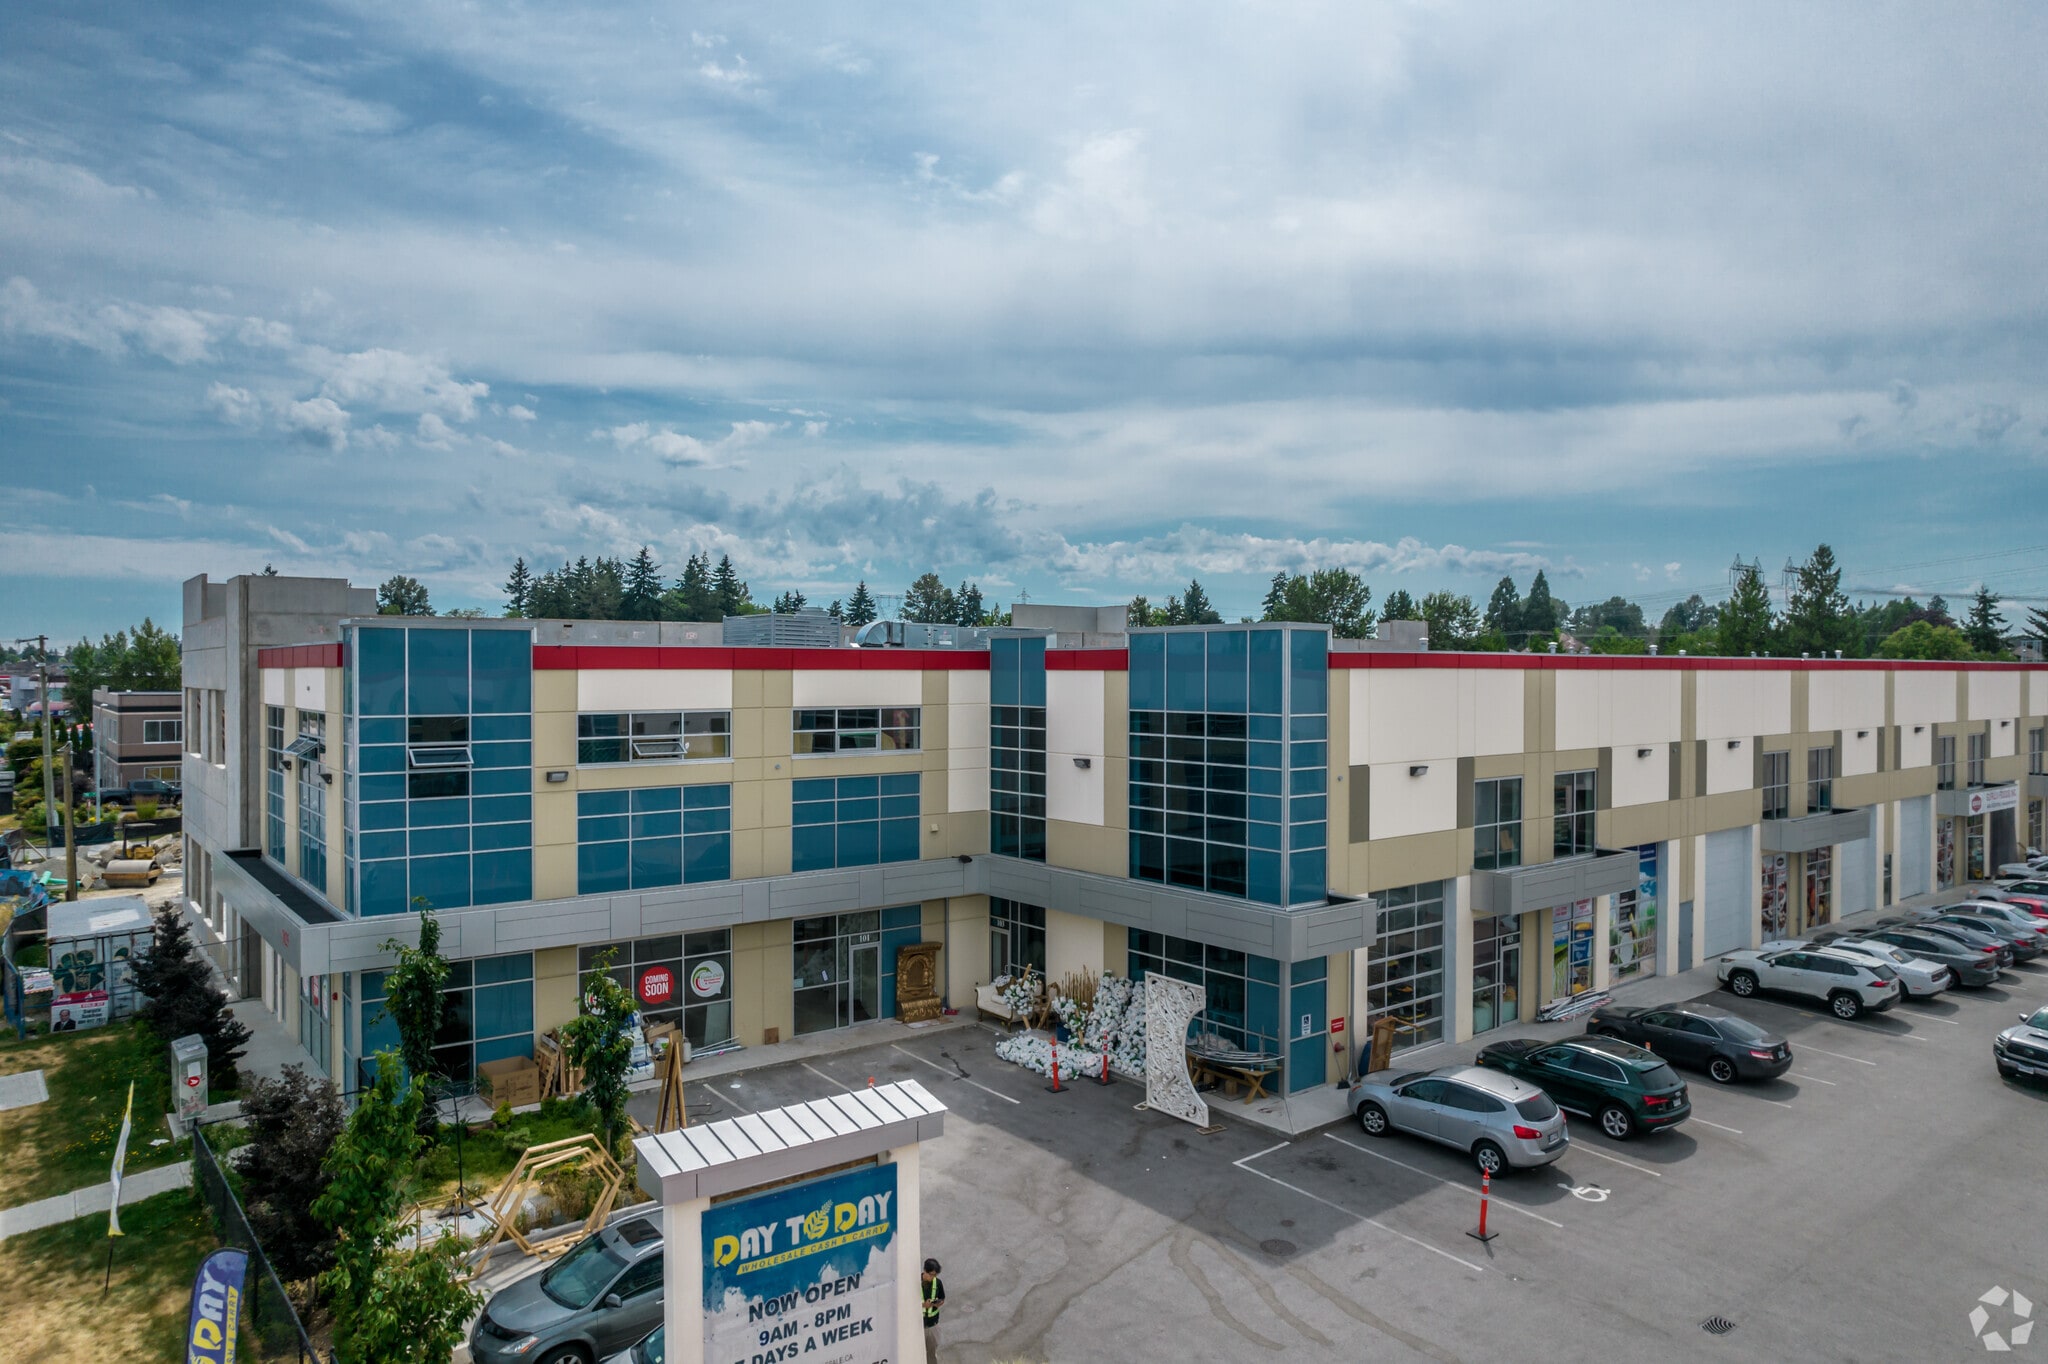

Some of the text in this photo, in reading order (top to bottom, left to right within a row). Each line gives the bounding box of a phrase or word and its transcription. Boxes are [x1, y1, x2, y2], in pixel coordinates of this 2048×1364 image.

[860, 934, 870, 942] 101
[645, 974, 669, 985] COMING
[645, 982, 669, 996] SOON
[714, 1191, 892, 1268] DAY TO DAY
[741, 1247, 806, 1273] WHOLESALE
[810, 1240, 837, 1254] CASH
[852, 1225, 886, 1241] CARRY
[193, 1268, 226, 1350] DAY
[228, 1292, 237, 1330] CARRY
[749, 1273, 862, 1323] NOW OPEN
[751, 1317, 873, 1364] DAYS A WEEK
[759, 1320, 798, 1346] 9AM
[814, 1304, 851, 1328] 8PM
